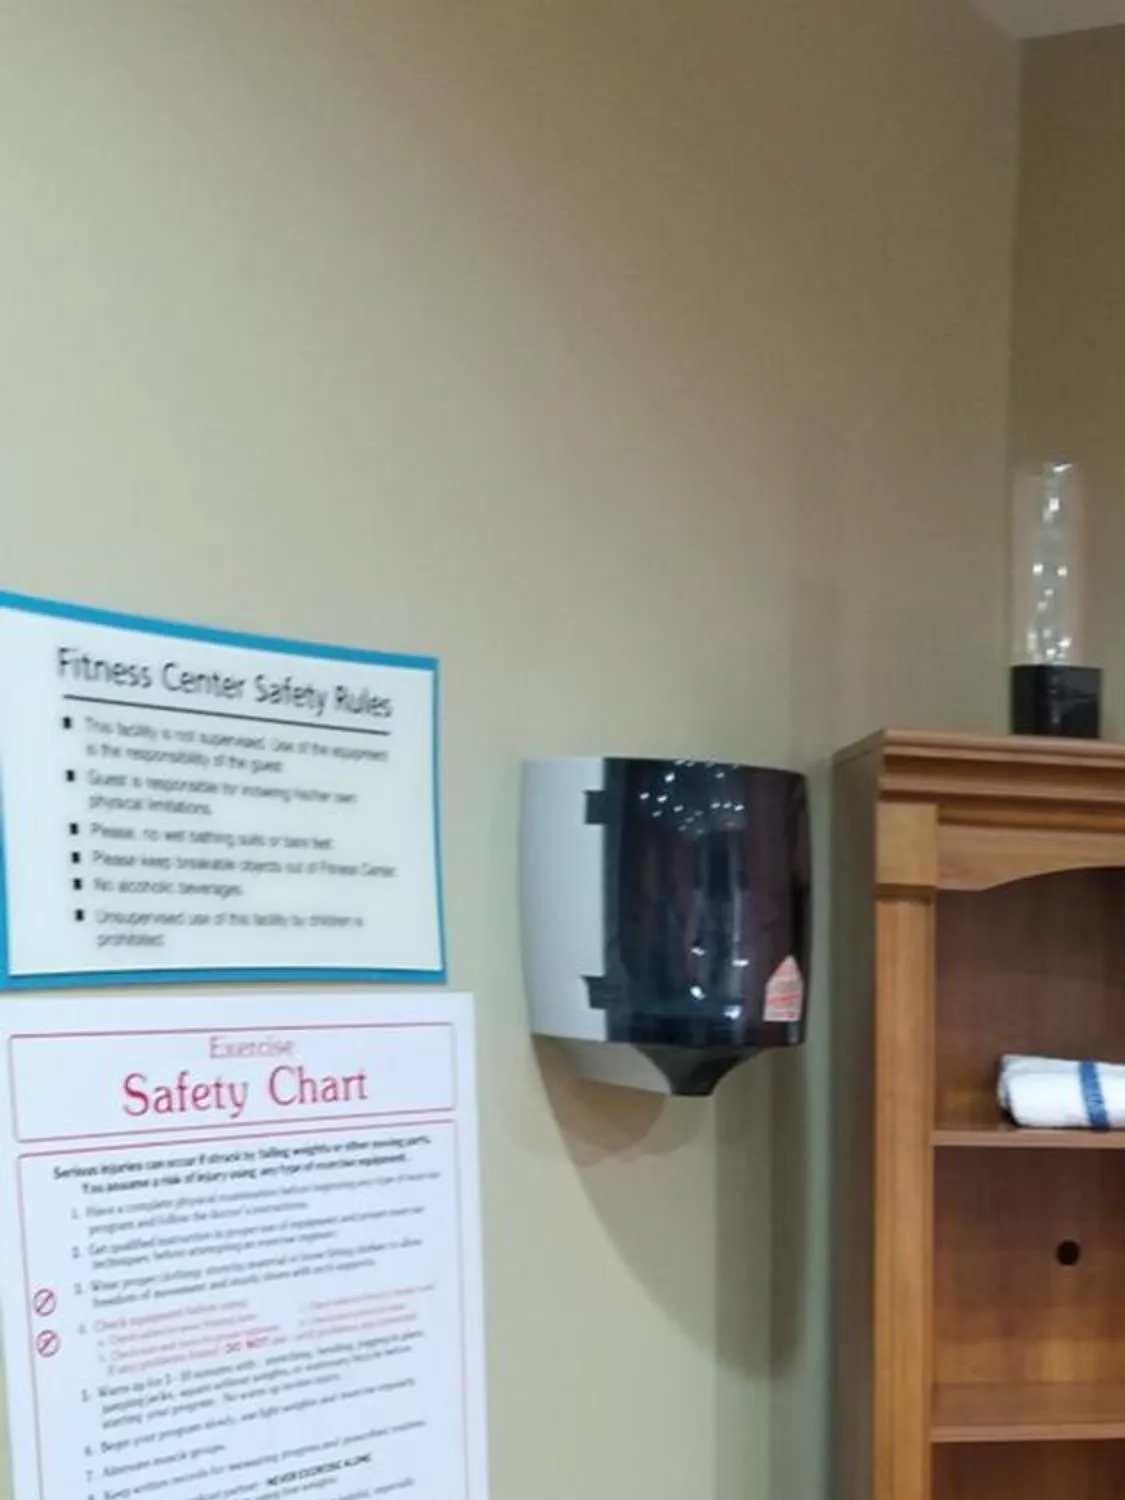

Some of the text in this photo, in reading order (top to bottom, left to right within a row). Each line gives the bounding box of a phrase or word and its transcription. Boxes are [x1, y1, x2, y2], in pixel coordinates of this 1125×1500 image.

[56, 646, 392, 718] Fitness Center Safety Rules
[207, 1032, 296, 1059] Exercise
[120, 1060, 367, 1126] Safety Chart
